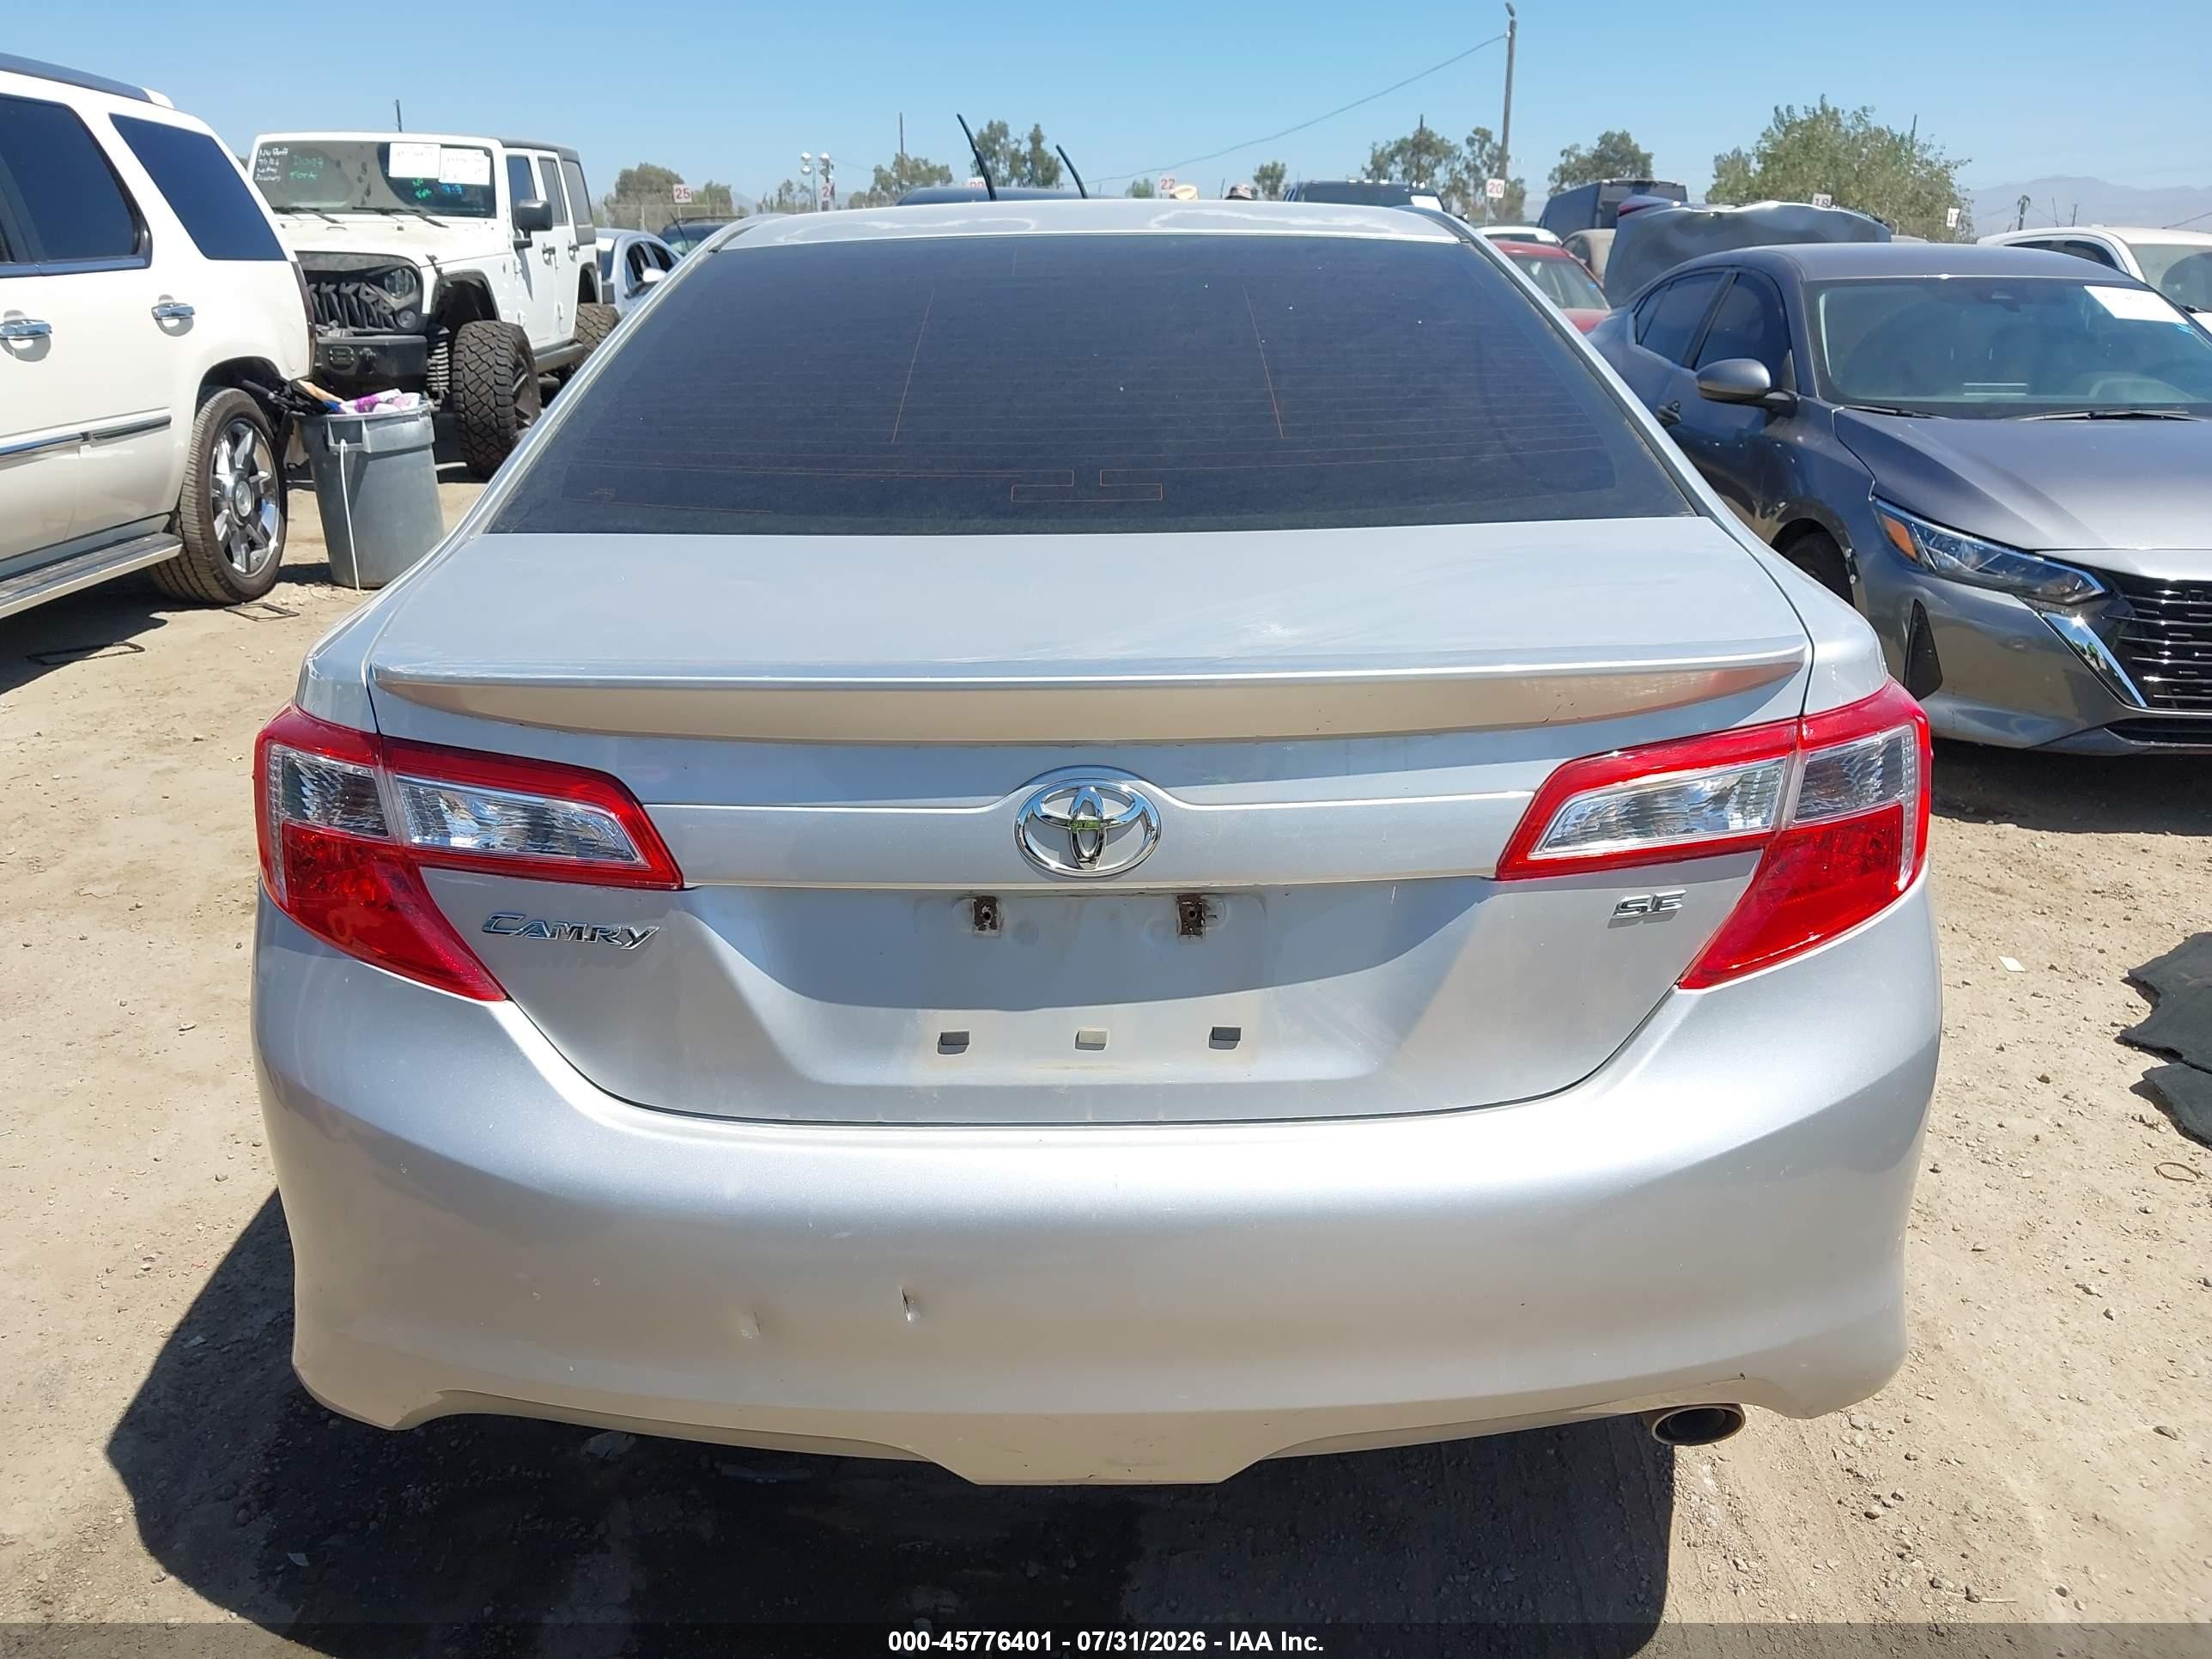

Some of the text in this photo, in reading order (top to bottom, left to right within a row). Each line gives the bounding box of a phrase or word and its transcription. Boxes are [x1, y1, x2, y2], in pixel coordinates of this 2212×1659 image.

[1161, 178, 1176, 190] 22
[1489, 182, 1503, 194] 20
[675, 187, 691, 199] 25
[1613, 889, 1687, 919] SE
[482, 912, 660, 951] CAMRY
